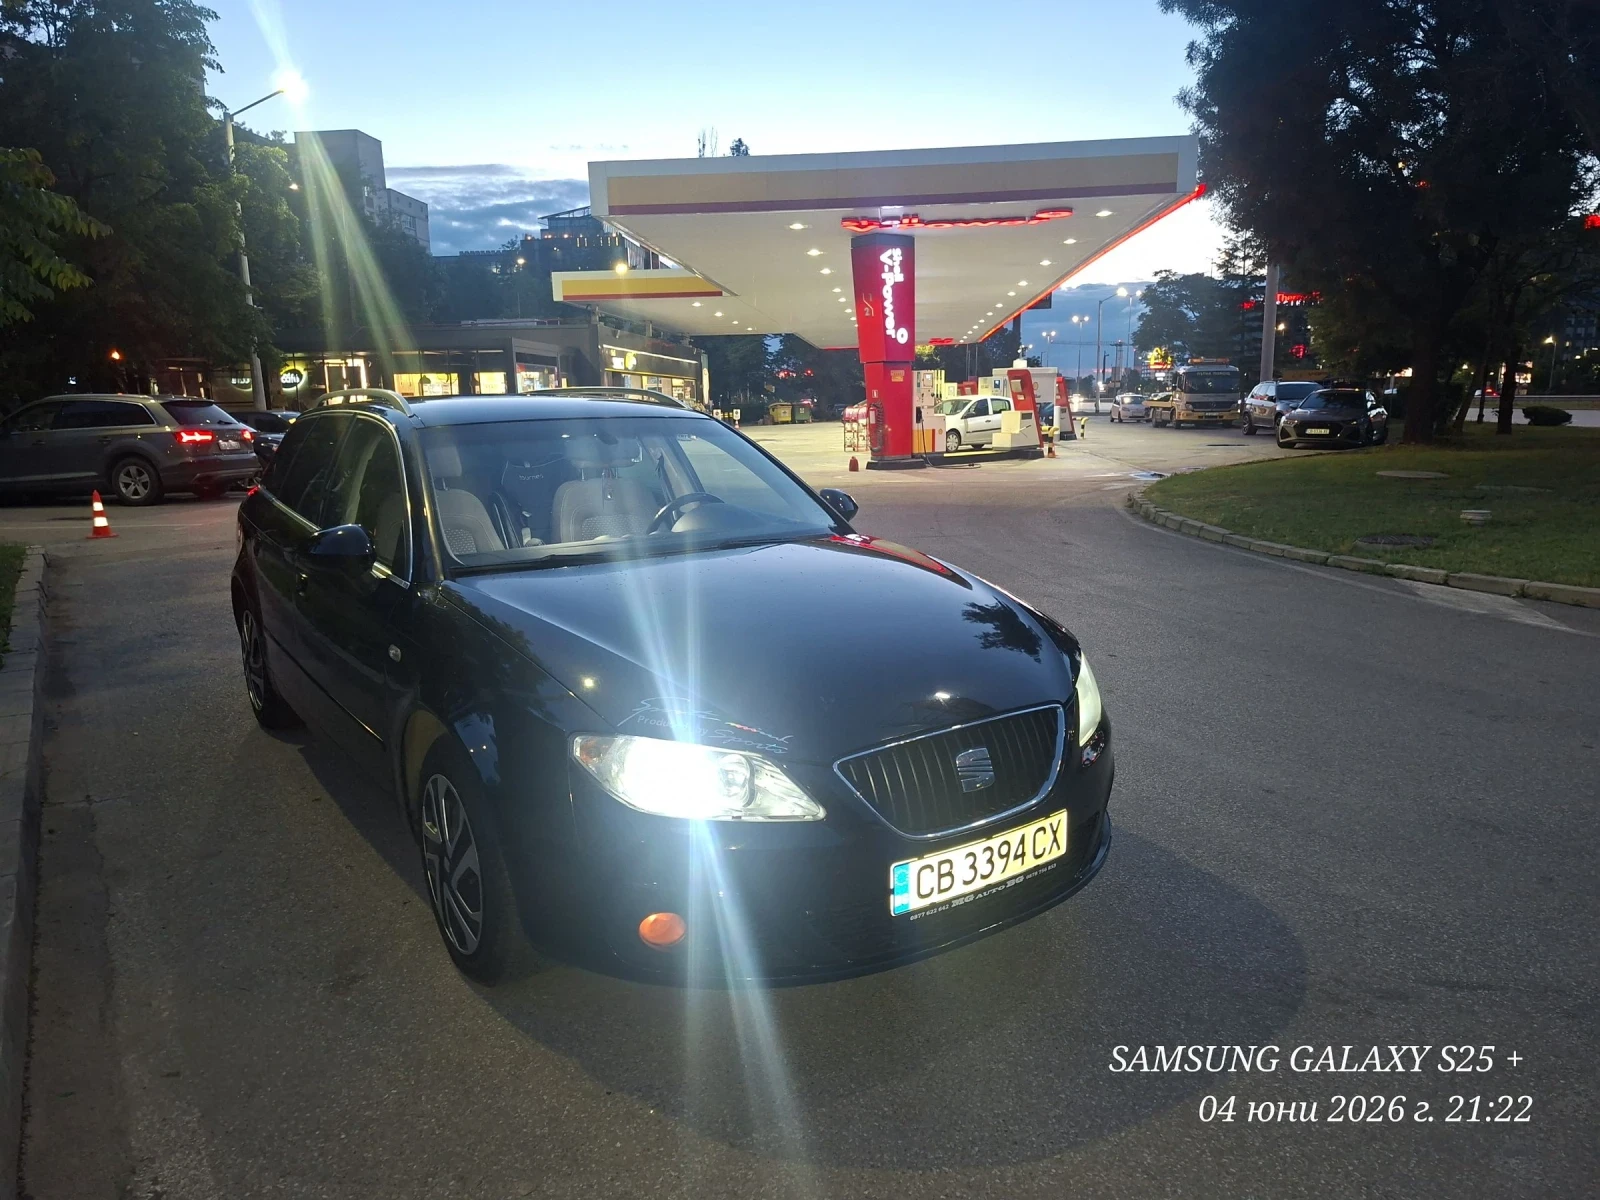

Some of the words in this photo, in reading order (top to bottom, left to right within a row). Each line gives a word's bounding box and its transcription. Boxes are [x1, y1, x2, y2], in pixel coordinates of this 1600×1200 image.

[879, 248, 896, 339] V-Power
[892, 247, 904, 283] Shell
[863, 306, 871, 317] 2
[916, 858, 955, 900] CB
[962, 833, 1026, 886] 3394
[1032, 819, 1062, 860] CX
